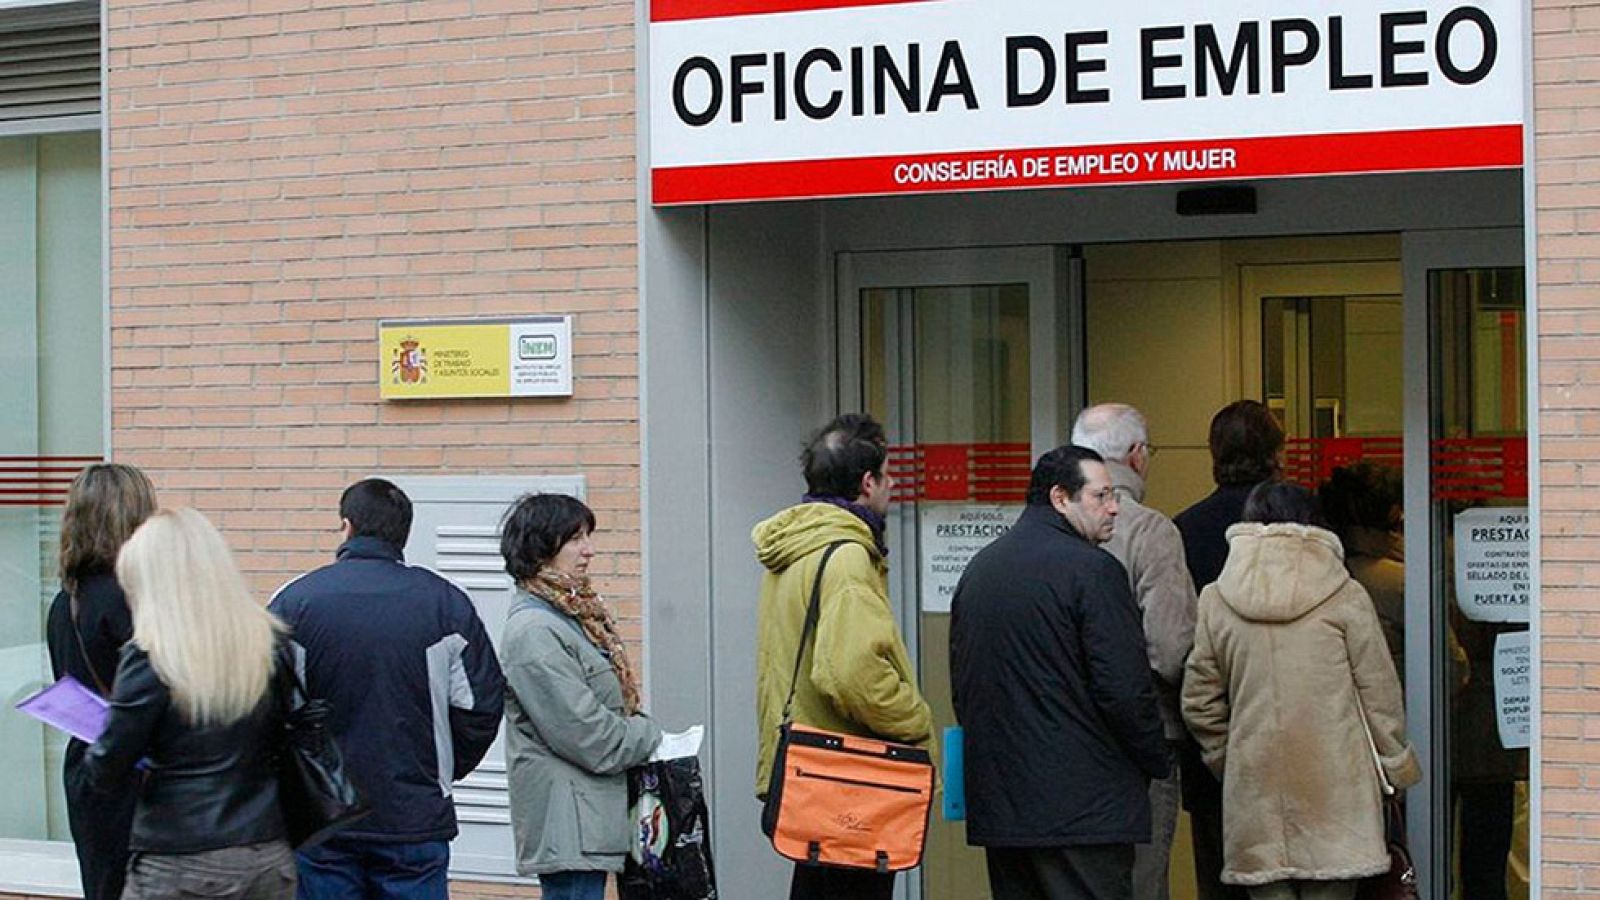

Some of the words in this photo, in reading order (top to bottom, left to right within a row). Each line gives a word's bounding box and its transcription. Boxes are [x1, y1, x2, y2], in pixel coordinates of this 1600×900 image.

[672, 40, 979, 127] OFICINA
[1005, 29, 1110, 108] DE
[1140, 5, 1499, 101] EMPLEO
[894, 153, 1017, 184] CONSEJERÍA
[1022, 156, 1049, 178] DE
[1054, 152, 1139, 176] EMPLEO
[1143, 152, 1159, 172] Y
[1163, 148, 1236, 172] MUJER
[1467, 571, 1508, 581] SELLADO
[1509, 571, 1521, 581] DE
[1474, 593, 1518, 606] PUERTA
